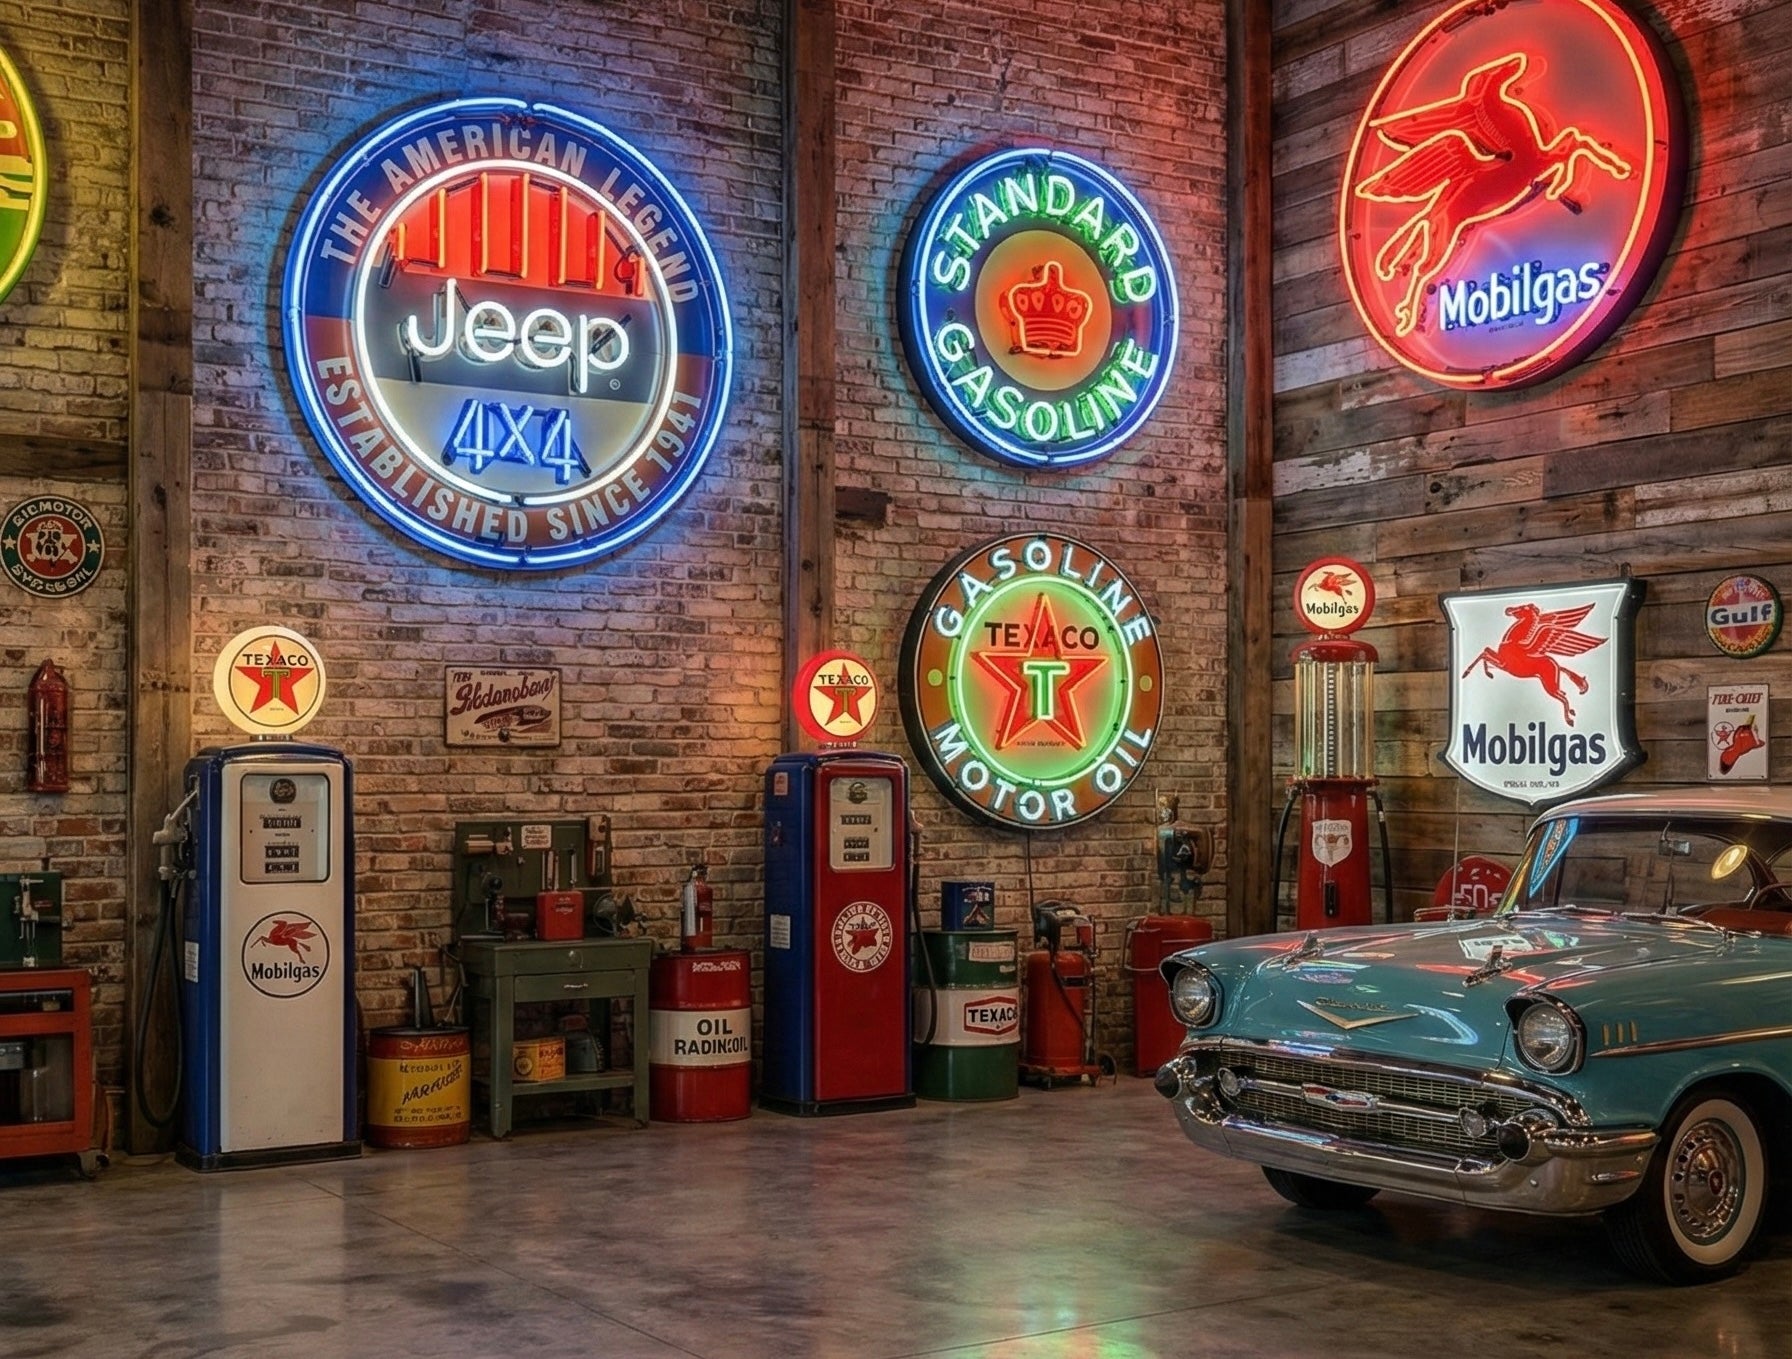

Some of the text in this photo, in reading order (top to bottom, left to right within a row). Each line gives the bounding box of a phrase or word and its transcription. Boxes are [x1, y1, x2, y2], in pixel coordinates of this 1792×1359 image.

[320, 121, 700, 304] THE AMERICAN LEGEND
[932, 172, 1157, 304] STANDARD
[1439, 261, 1602, 331] Mobilgas
[406, 278, 631, 395] Jeep
[936, 321, 1160, 443] GASOLINE
[316, 355, 703, 544] ESTABLISHED SINCE 1941
[933, 539, 1153, 647] GASOLINE
[1305, 601, 1360, 618] Mobilgas
[1710, 603, 1773, 626] Gulf
[242, 653, 309, 667] TEXACO
[984, 621, 1100, 650] TEXACO
[818, 674, 869, 685] TEXACO
[933, 721, 1152, 822] MOTOR OIL
[1462, 721, 1607, 777] Mobilgas
[251, 962, 321, 983] Mobilgas
[696, 1019, 733, 1036] OIL
